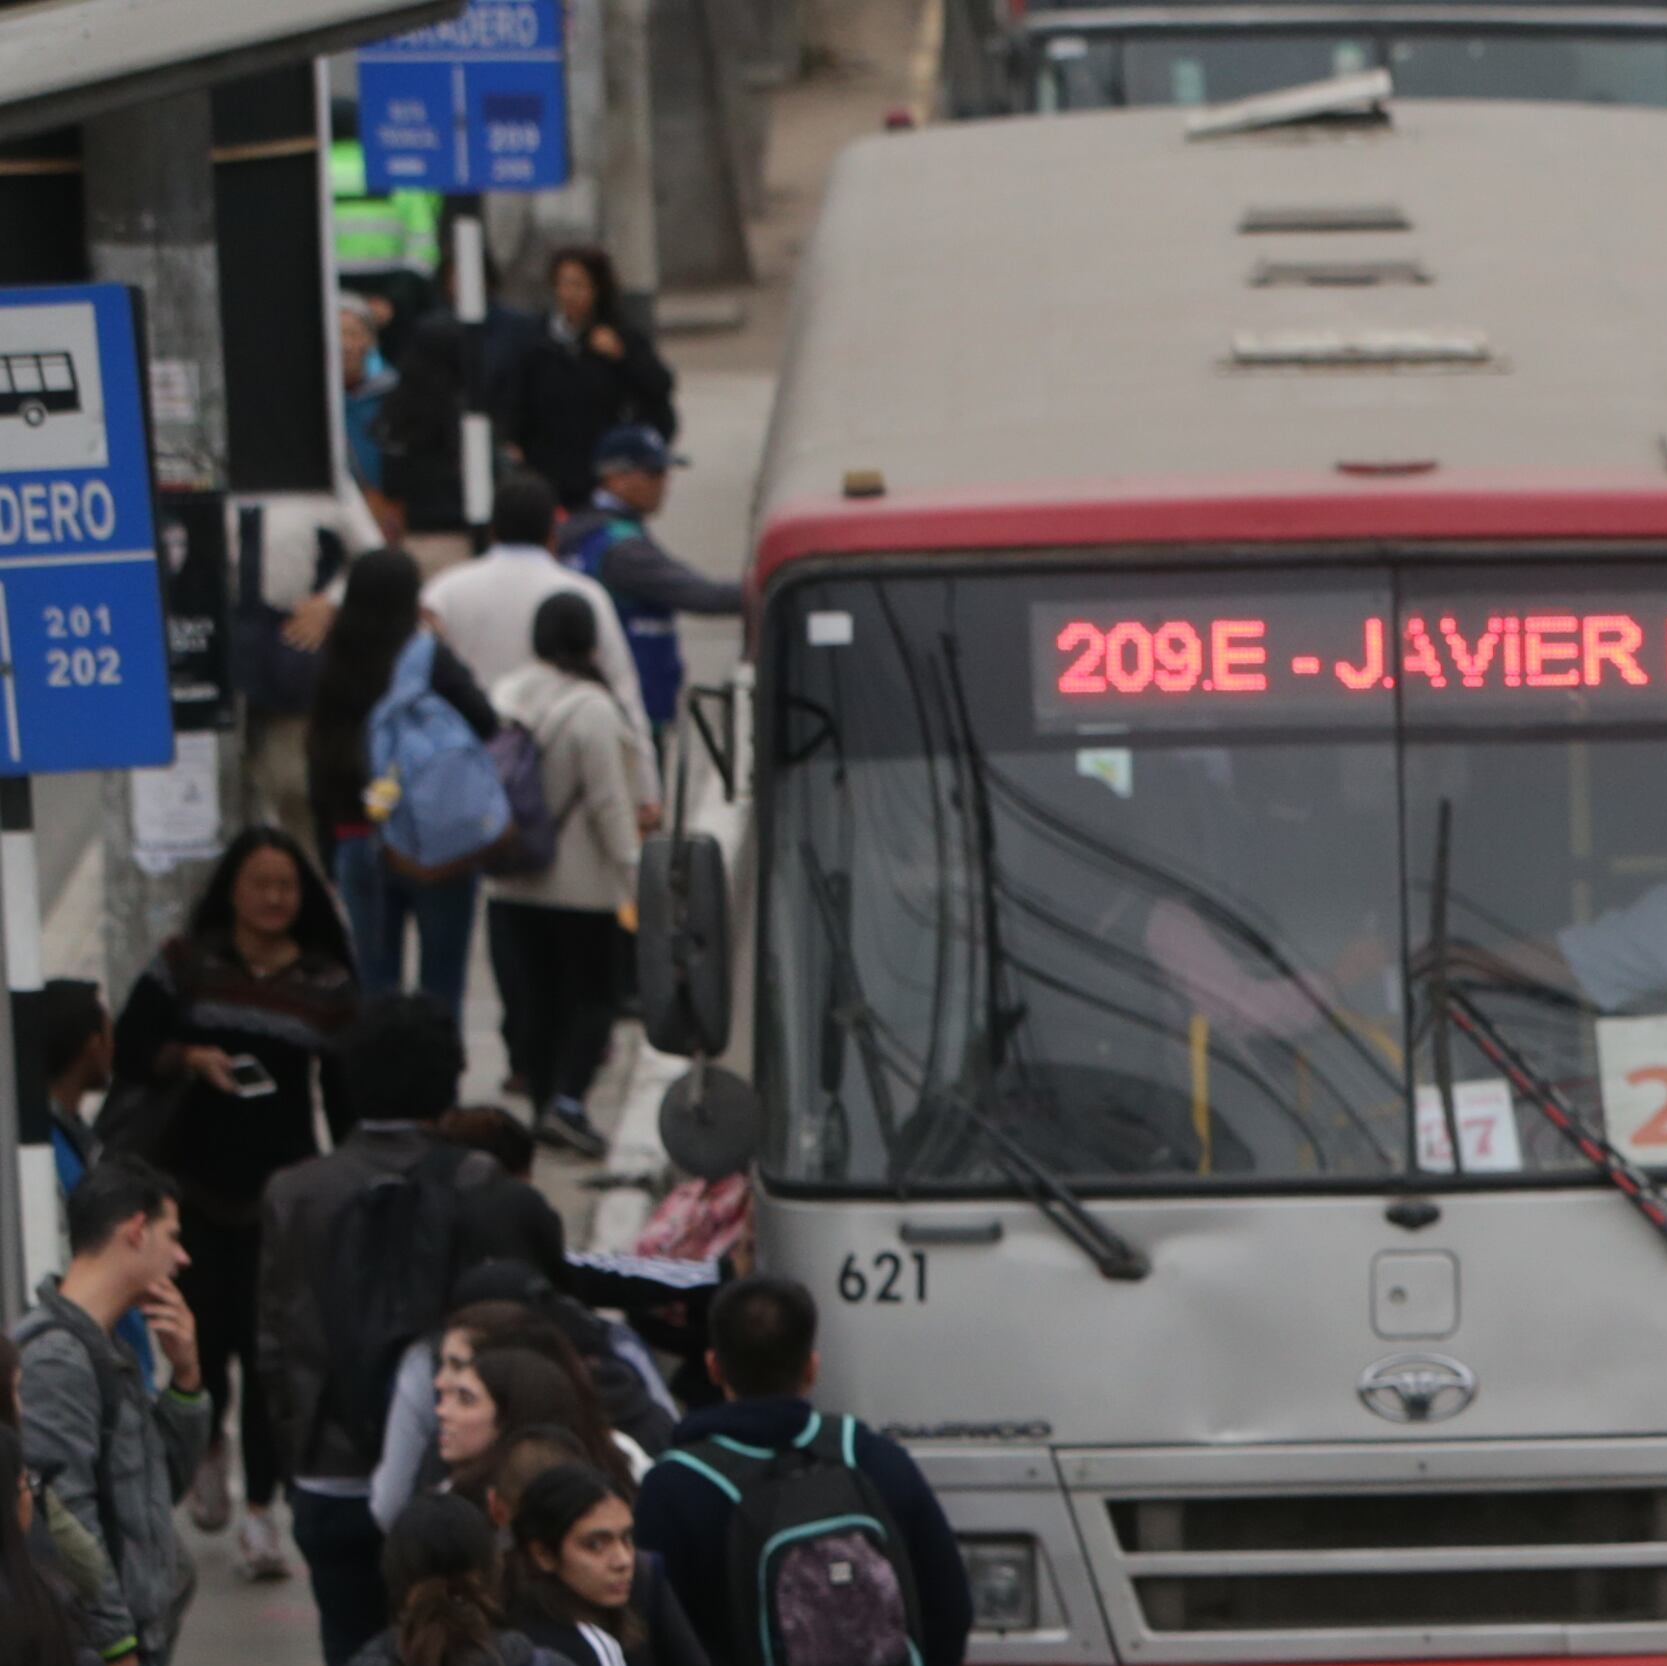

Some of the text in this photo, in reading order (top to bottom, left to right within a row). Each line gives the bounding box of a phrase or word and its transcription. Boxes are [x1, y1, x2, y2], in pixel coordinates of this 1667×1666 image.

[44, 603, 112, 638] 201
[47, 647, 122, 687] 202
[838, 1250, 928, 1303] 621
